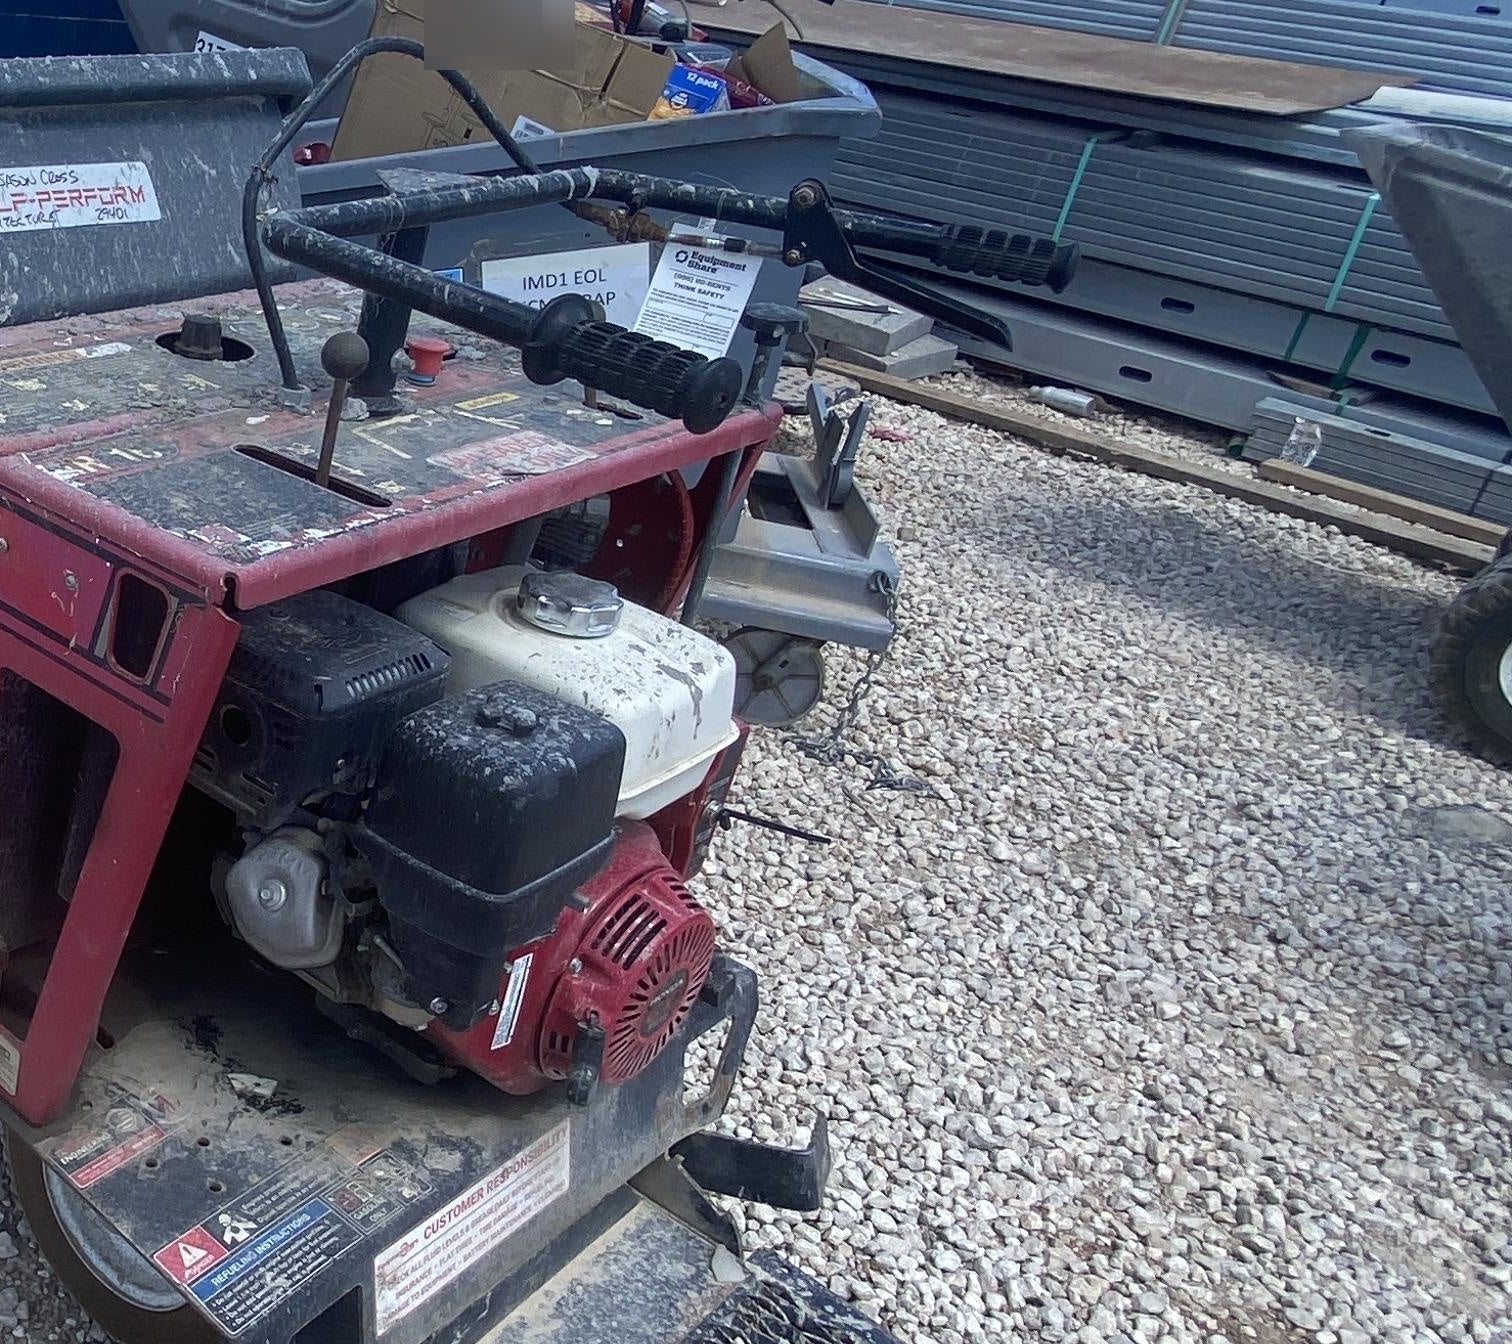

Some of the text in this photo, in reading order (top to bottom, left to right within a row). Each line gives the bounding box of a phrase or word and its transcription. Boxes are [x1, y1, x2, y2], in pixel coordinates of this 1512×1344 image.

[522, 268, 608, 291] IMD1 EOL
[690, 250, 747, 272] Equipment
[423, 1124, 568, 1241] CUSTOMER RESPONSIBILITY
[210, 1249, 258, 1286] REFUELING
[253, 1212, 312, 1255] INSTRUCTIONS
